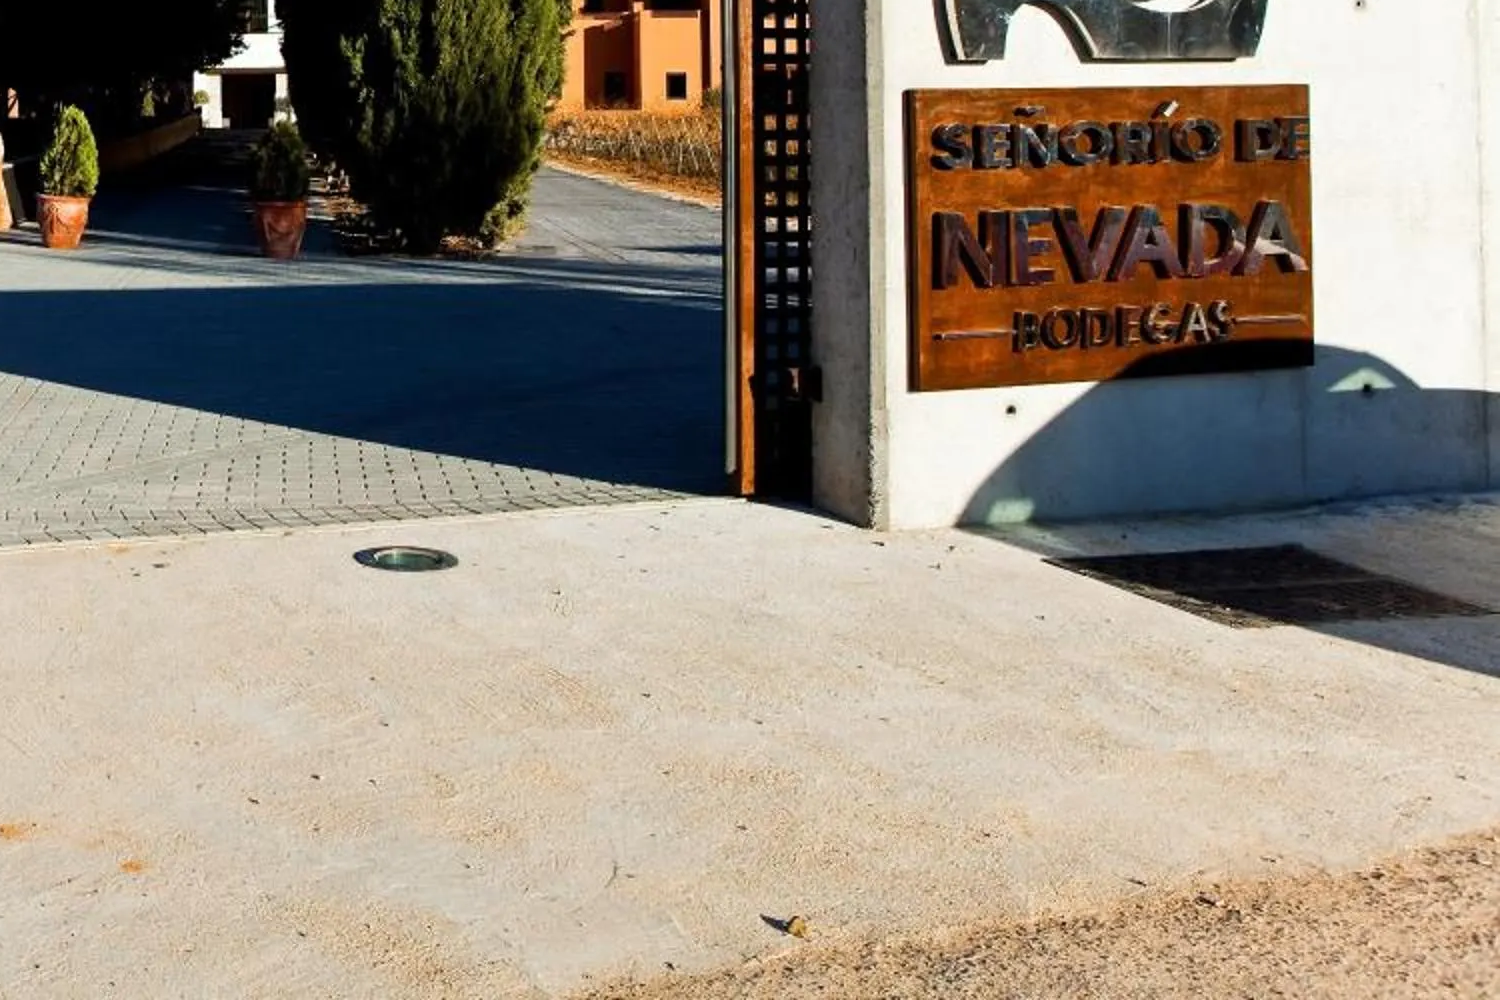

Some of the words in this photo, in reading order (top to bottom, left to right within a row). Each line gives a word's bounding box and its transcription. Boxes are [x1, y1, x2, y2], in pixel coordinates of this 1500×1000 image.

[931, 101, 1222, 169] SEÑORÍO
[1234, 115, 1309, 162] DE
[931, 200, 1308, 289] NEVADA
[1012, 301, 1233, 352] BODEGAS
